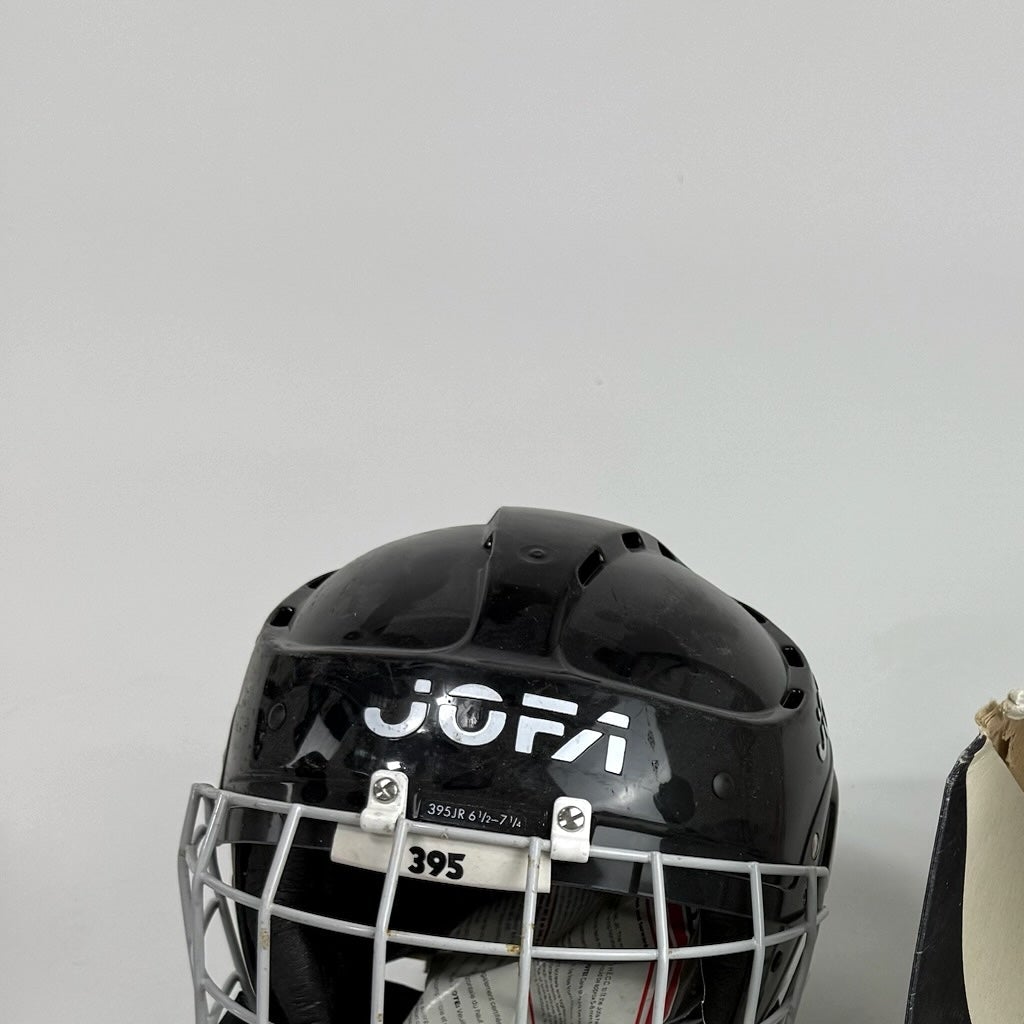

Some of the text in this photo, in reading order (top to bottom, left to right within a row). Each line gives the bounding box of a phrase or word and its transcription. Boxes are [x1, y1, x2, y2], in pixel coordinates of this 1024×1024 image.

[363, 679, 631, 775] JOFA
[427, 803, 465, 820] 395JR
[408, 846, 466, 880] 395
